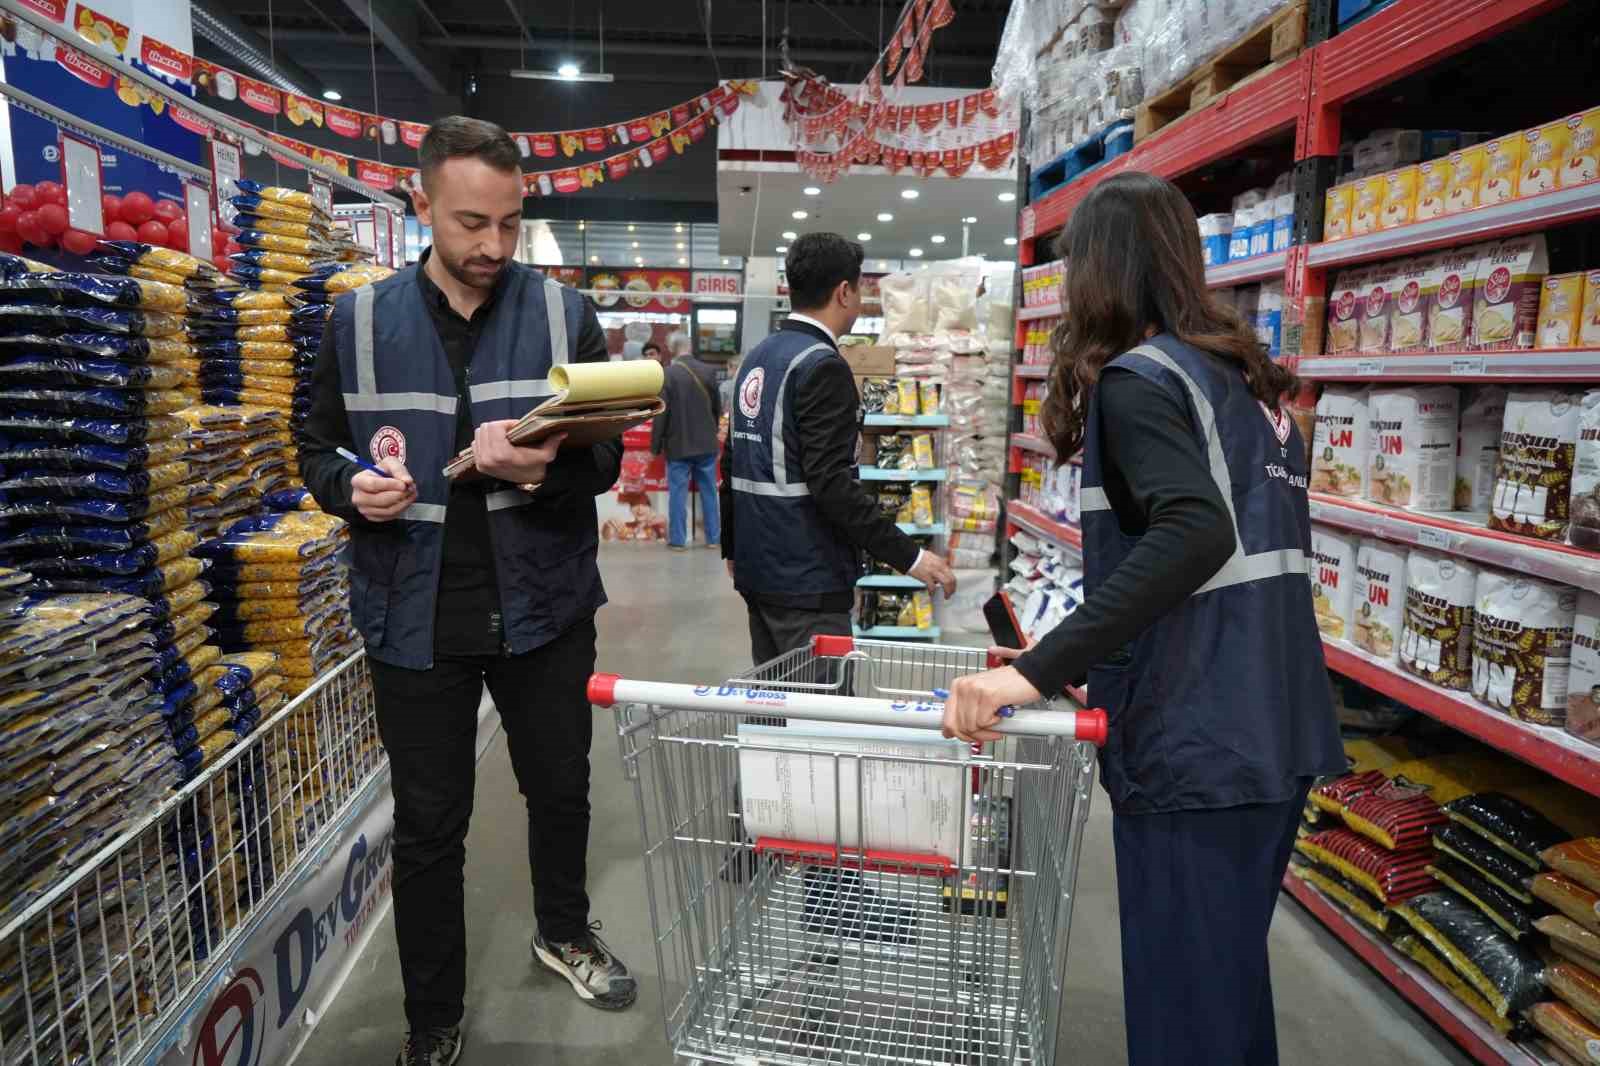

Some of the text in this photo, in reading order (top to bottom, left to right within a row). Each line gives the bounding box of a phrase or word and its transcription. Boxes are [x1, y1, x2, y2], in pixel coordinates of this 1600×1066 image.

[1329, 430, 1353, 449] UN
[1379, 435, 1404, 455] UN
[1319, 567, 1339, 589] UN
[1368, 583, 1390, 607] UN
[273, 826, 393, 1029] DEVGRO
